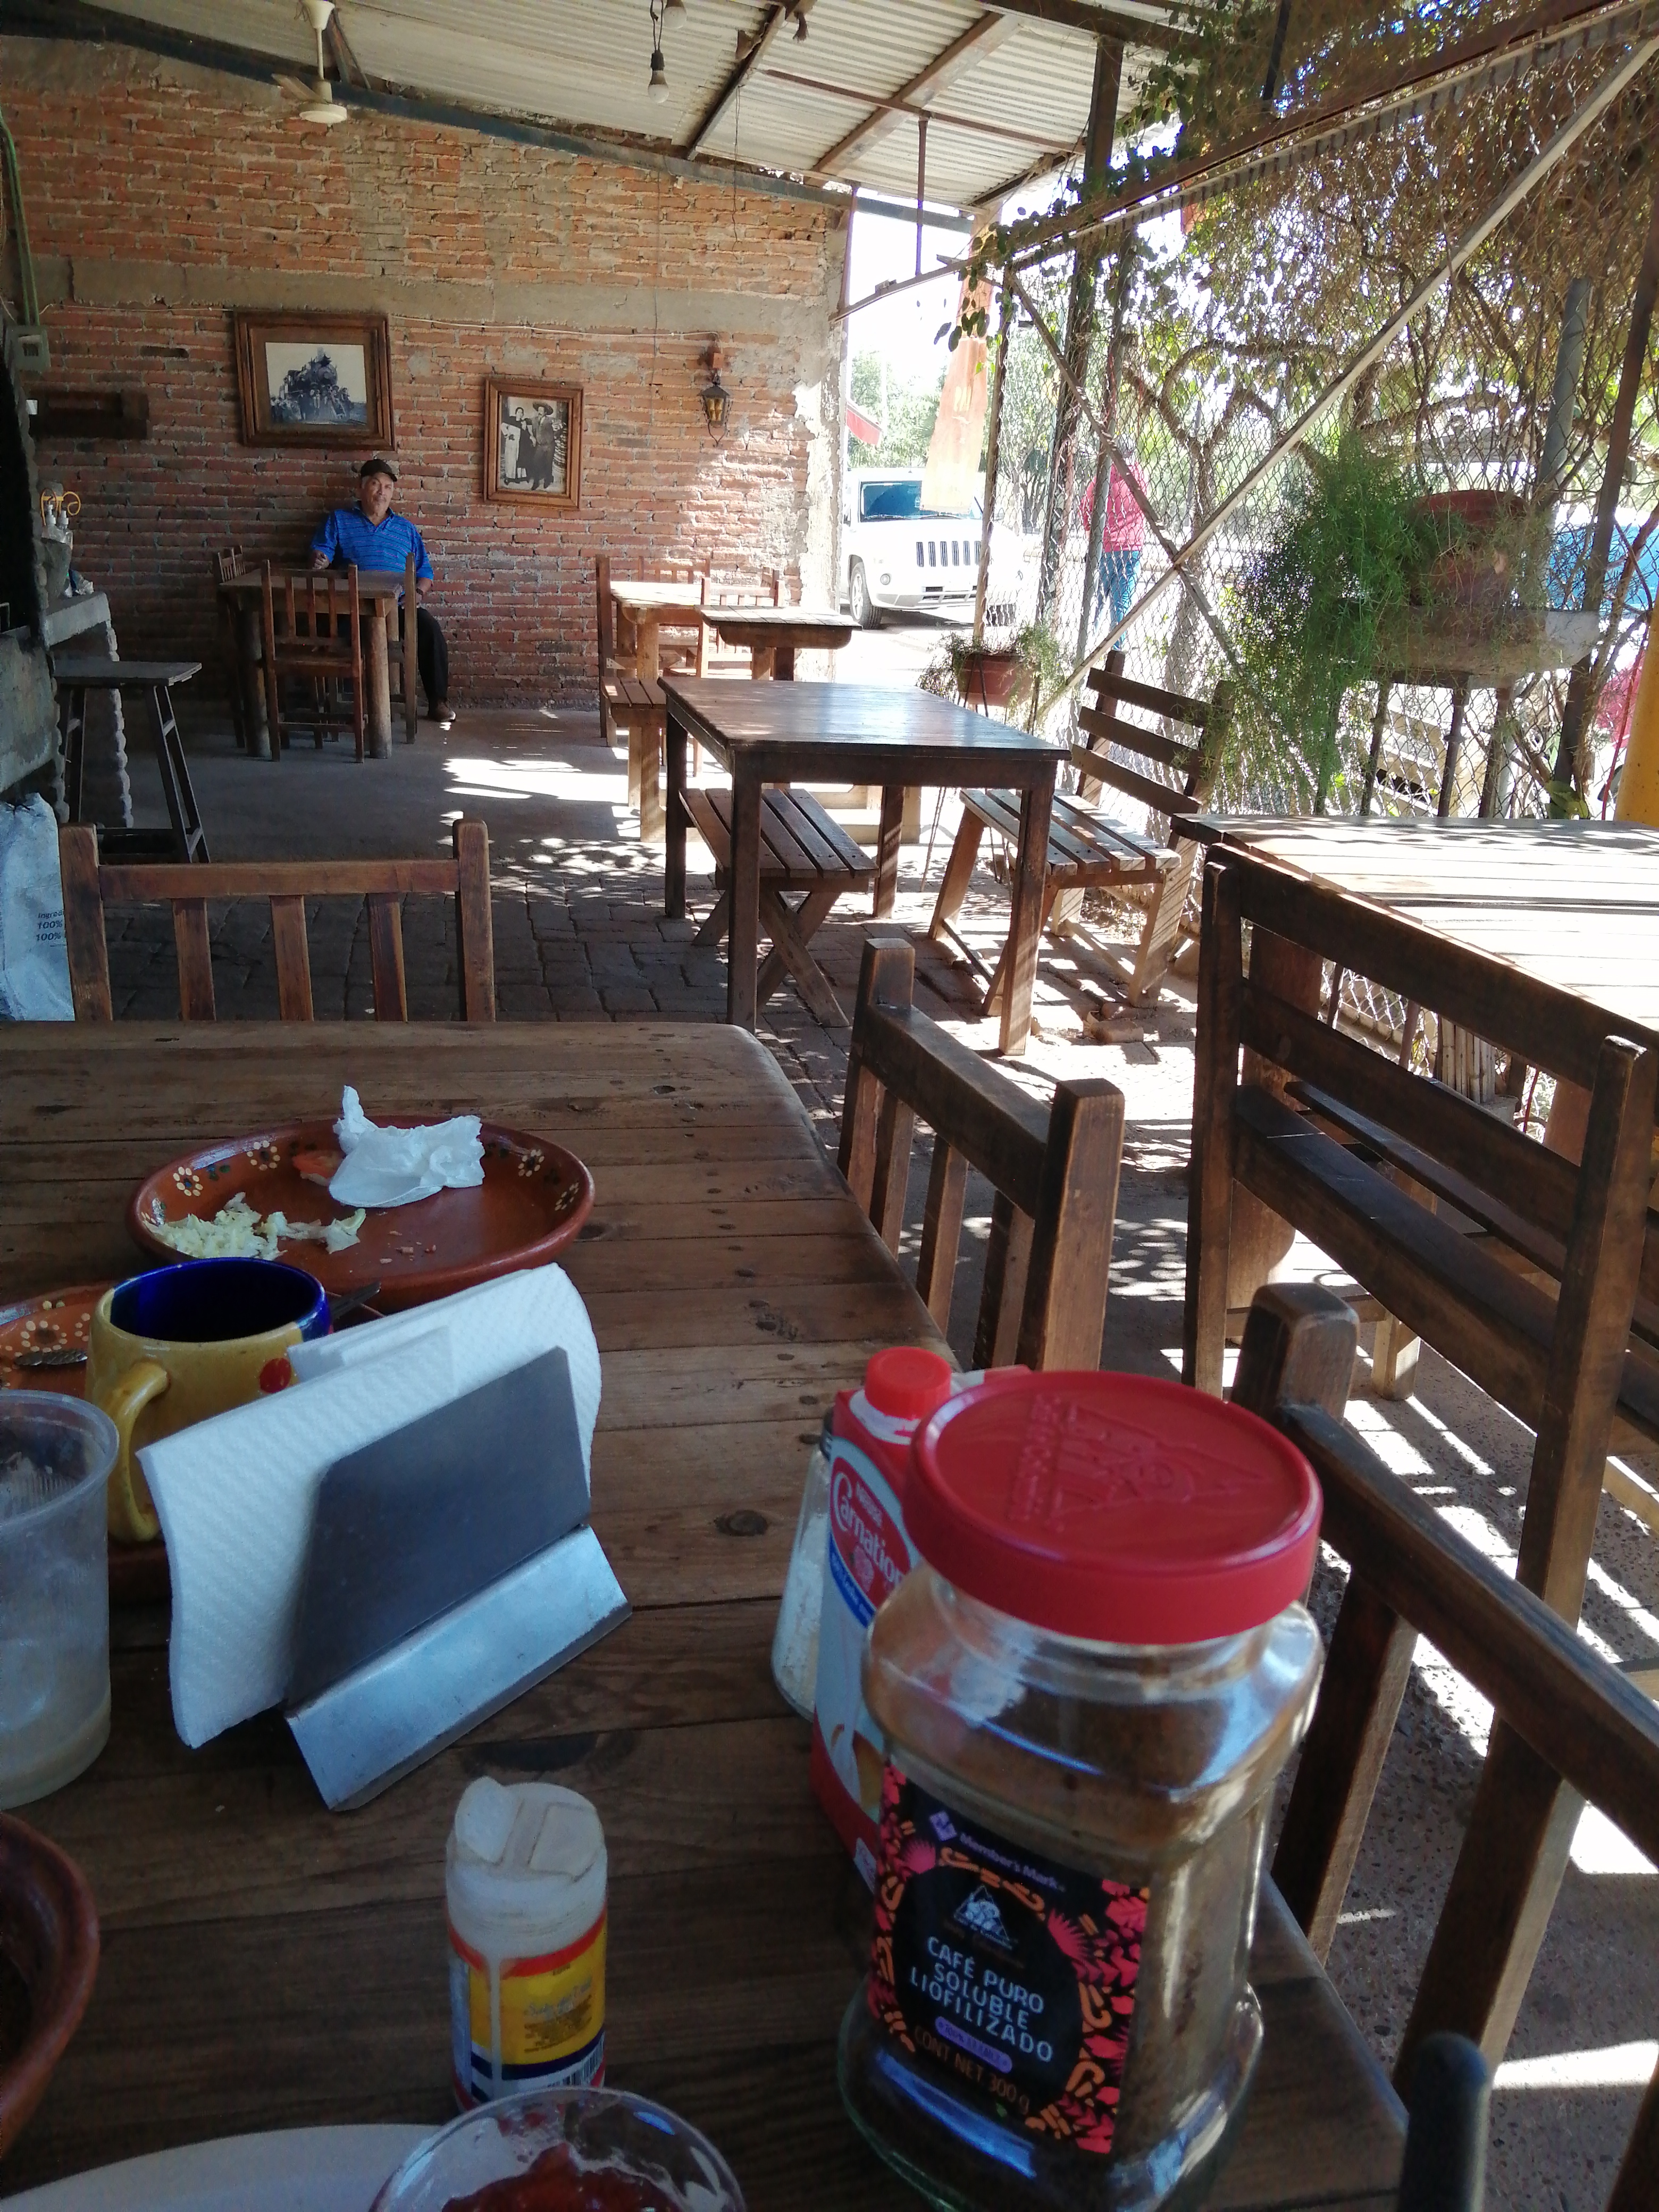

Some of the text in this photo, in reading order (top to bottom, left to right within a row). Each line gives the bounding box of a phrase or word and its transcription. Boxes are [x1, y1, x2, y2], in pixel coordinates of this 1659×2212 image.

[36, 932, 61, 942] 100%
[38, 920, 63, 929] 100%
[927, 1936, 976, 1979] CAFÉ
[984, 1969, 1045, 2014] PURO
[934, 1962, 1029, 2030] SOLUBLE
[910, 1966, 1053, 2063] LIOFILIZADO
[915, 2025, 949, 2062] CONT
[954, 2052, 983, 2082] NET
[989, 2073, 1017, 2102] 300
[1019, 2094, 1030, 2115] g
